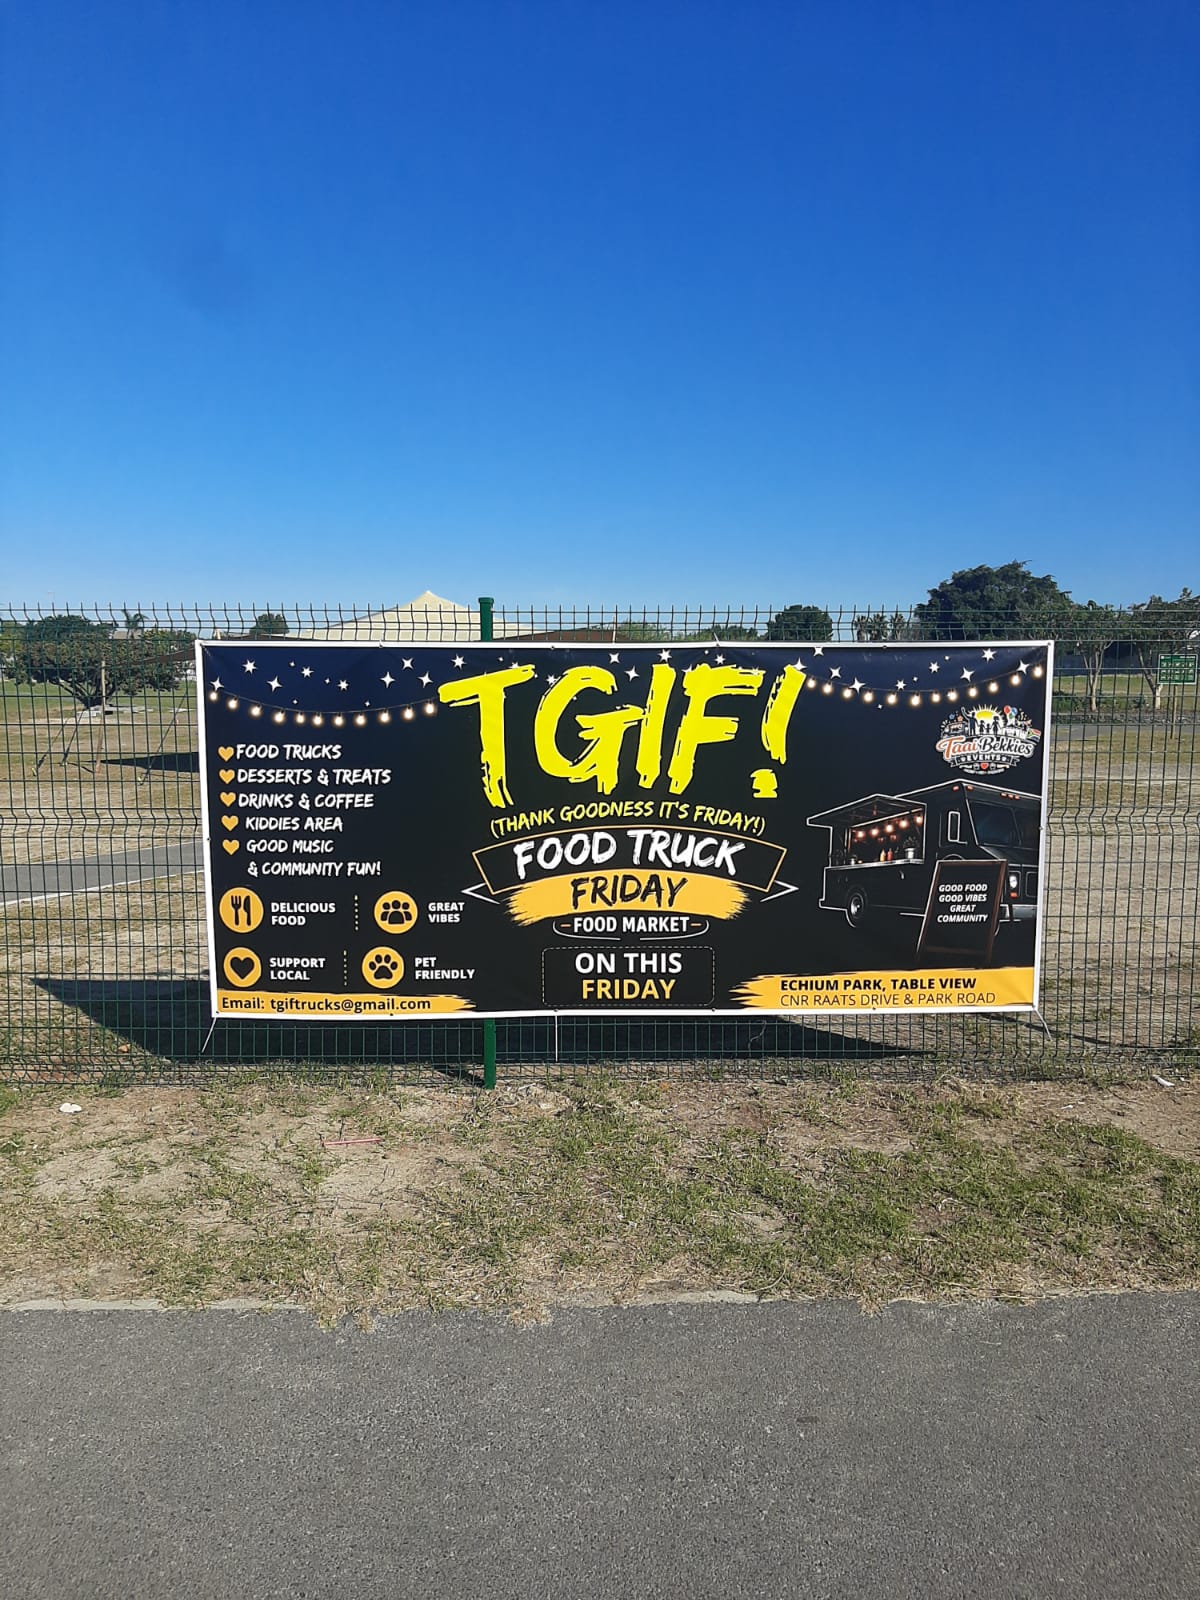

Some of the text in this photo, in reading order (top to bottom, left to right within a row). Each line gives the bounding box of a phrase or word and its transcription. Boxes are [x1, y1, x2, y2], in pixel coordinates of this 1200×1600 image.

[437, 663, 806, 808] TGIF!
[236, 744, 342, 760] FOOD TRUCKS
[937, 735, 1034, 760] Taai Bekkies
[237, 768, 392, 786] DESSERTS & TREATS
[238, 793, 374, 810] DRINKS & COFFEE
[245, 817, 343, 832] KIDDIES AREA
[490, 801, 766, 838] (THANK GOODNESS IT'S FRIDAY!)
[246, 839, 334, 853] GOOD MUSIC
[513, 829, 746, 879] FOOD TRUCK
[247, 861, 381, 877] & COMMUNITY FUN!
[570, 874, 688, 909] FRIDAY
[938, 884, 963, 892] GOOD
[938, 894, 963, 902] GOOD
[271, 902, 336, 913] DELICIOUS
[428, 902, 465, 912] GREAT
[950, 904, 976, 912] GREAT
[271, 915, 306, 926] FOOD
[428, 914, 460, 923] VIBES
[573, 916, 690, 933] FOOD MARKET
[937, 914, 988, 922] COMMUNITY
[269, 957, 326, 968] SUPPORT
[414, 957, 437, 968] PET
[575, 953, 683, 974] ON THIS
[270, 970, 310, 981] LOCAL
[415, 969, 475, 980] FRIENDLY
[582, 979, 676, 999] FRIDAY
[781, 978, 976, 992] ECHIUM PARK, TABLE VIEW
[222, 997, 431, 1014] Email: tgiftrucks@gmail.com
[780, 993, 995, 1006] CNR RAATS DRIVE & PARK ROAD
